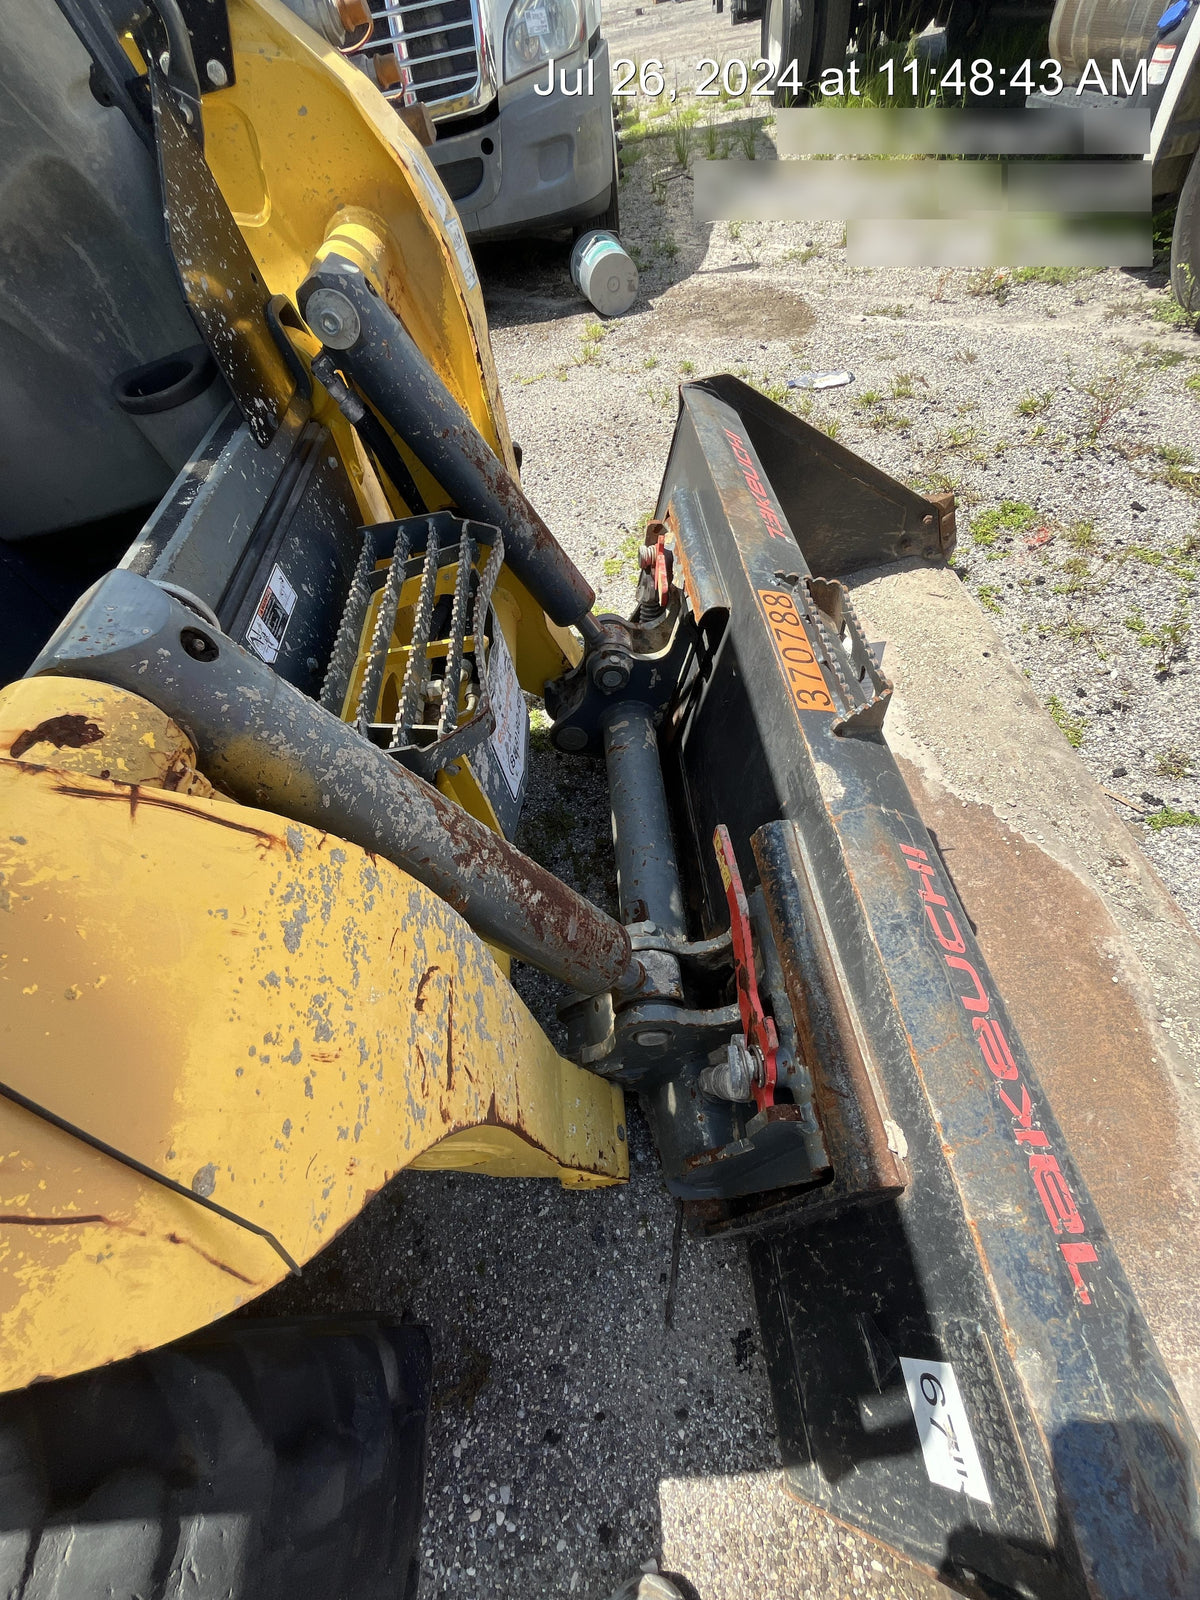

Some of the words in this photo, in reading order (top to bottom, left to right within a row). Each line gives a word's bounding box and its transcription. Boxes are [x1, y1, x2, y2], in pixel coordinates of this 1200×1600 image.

[723, 428, 786, 539] TAKEUCHI
[762, 593, 832, 708] 370788
[899, 842, 1099, 1305] TAKEUCHI
